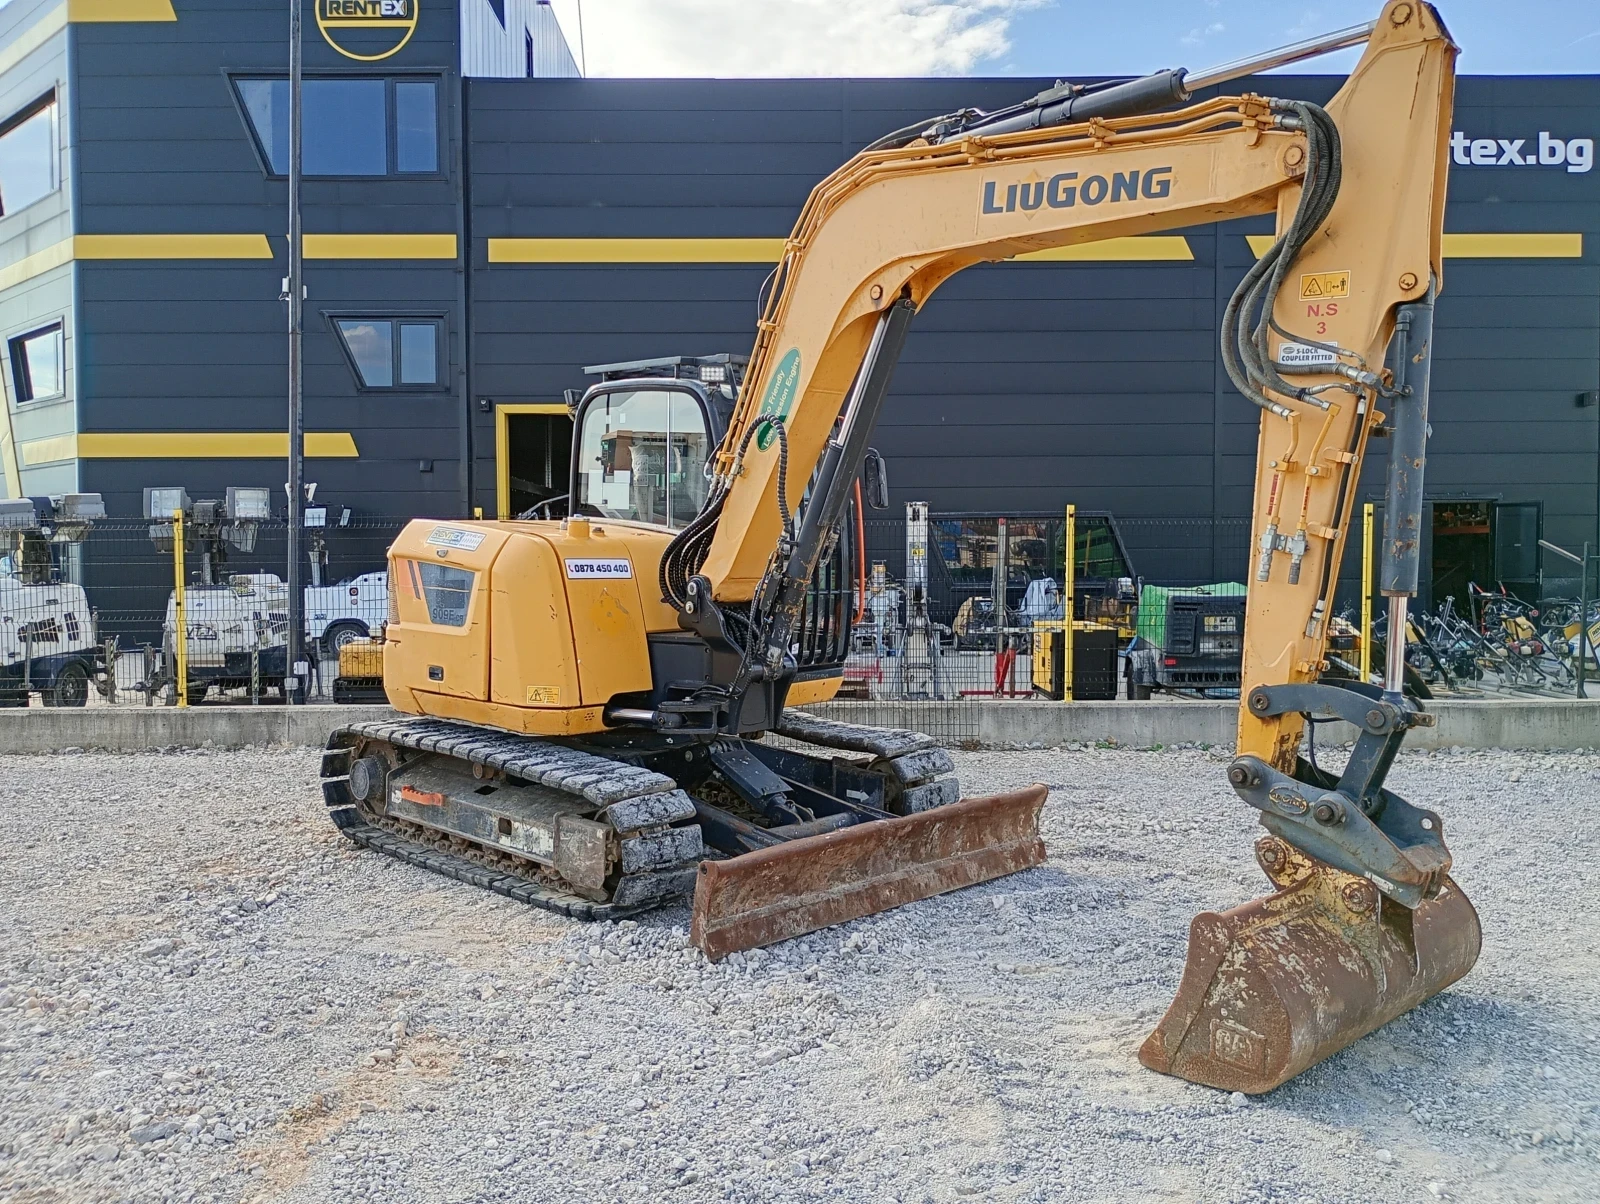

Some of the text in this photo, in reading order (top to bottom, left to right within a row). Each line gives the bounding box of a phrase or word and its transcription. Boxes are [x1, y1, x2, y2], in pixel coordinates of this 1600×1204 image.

[328, 0, 405, 16] RENTEX
[1450, 131, 1594, 173] tex.bg
[982, 166, 1173, 214] LIUGONG
[1307, 303, 1338, 318] N.S
[1316, 321, 1327, 334] 3
[1281, 354, 1310, 362] COUPLER
[768, 369, 786, 404] Friendly
[763, 428, 775, 448] Low
[785, 356, 800, 388] Engine
[574, 564, 629, 573] 0878 450 400
